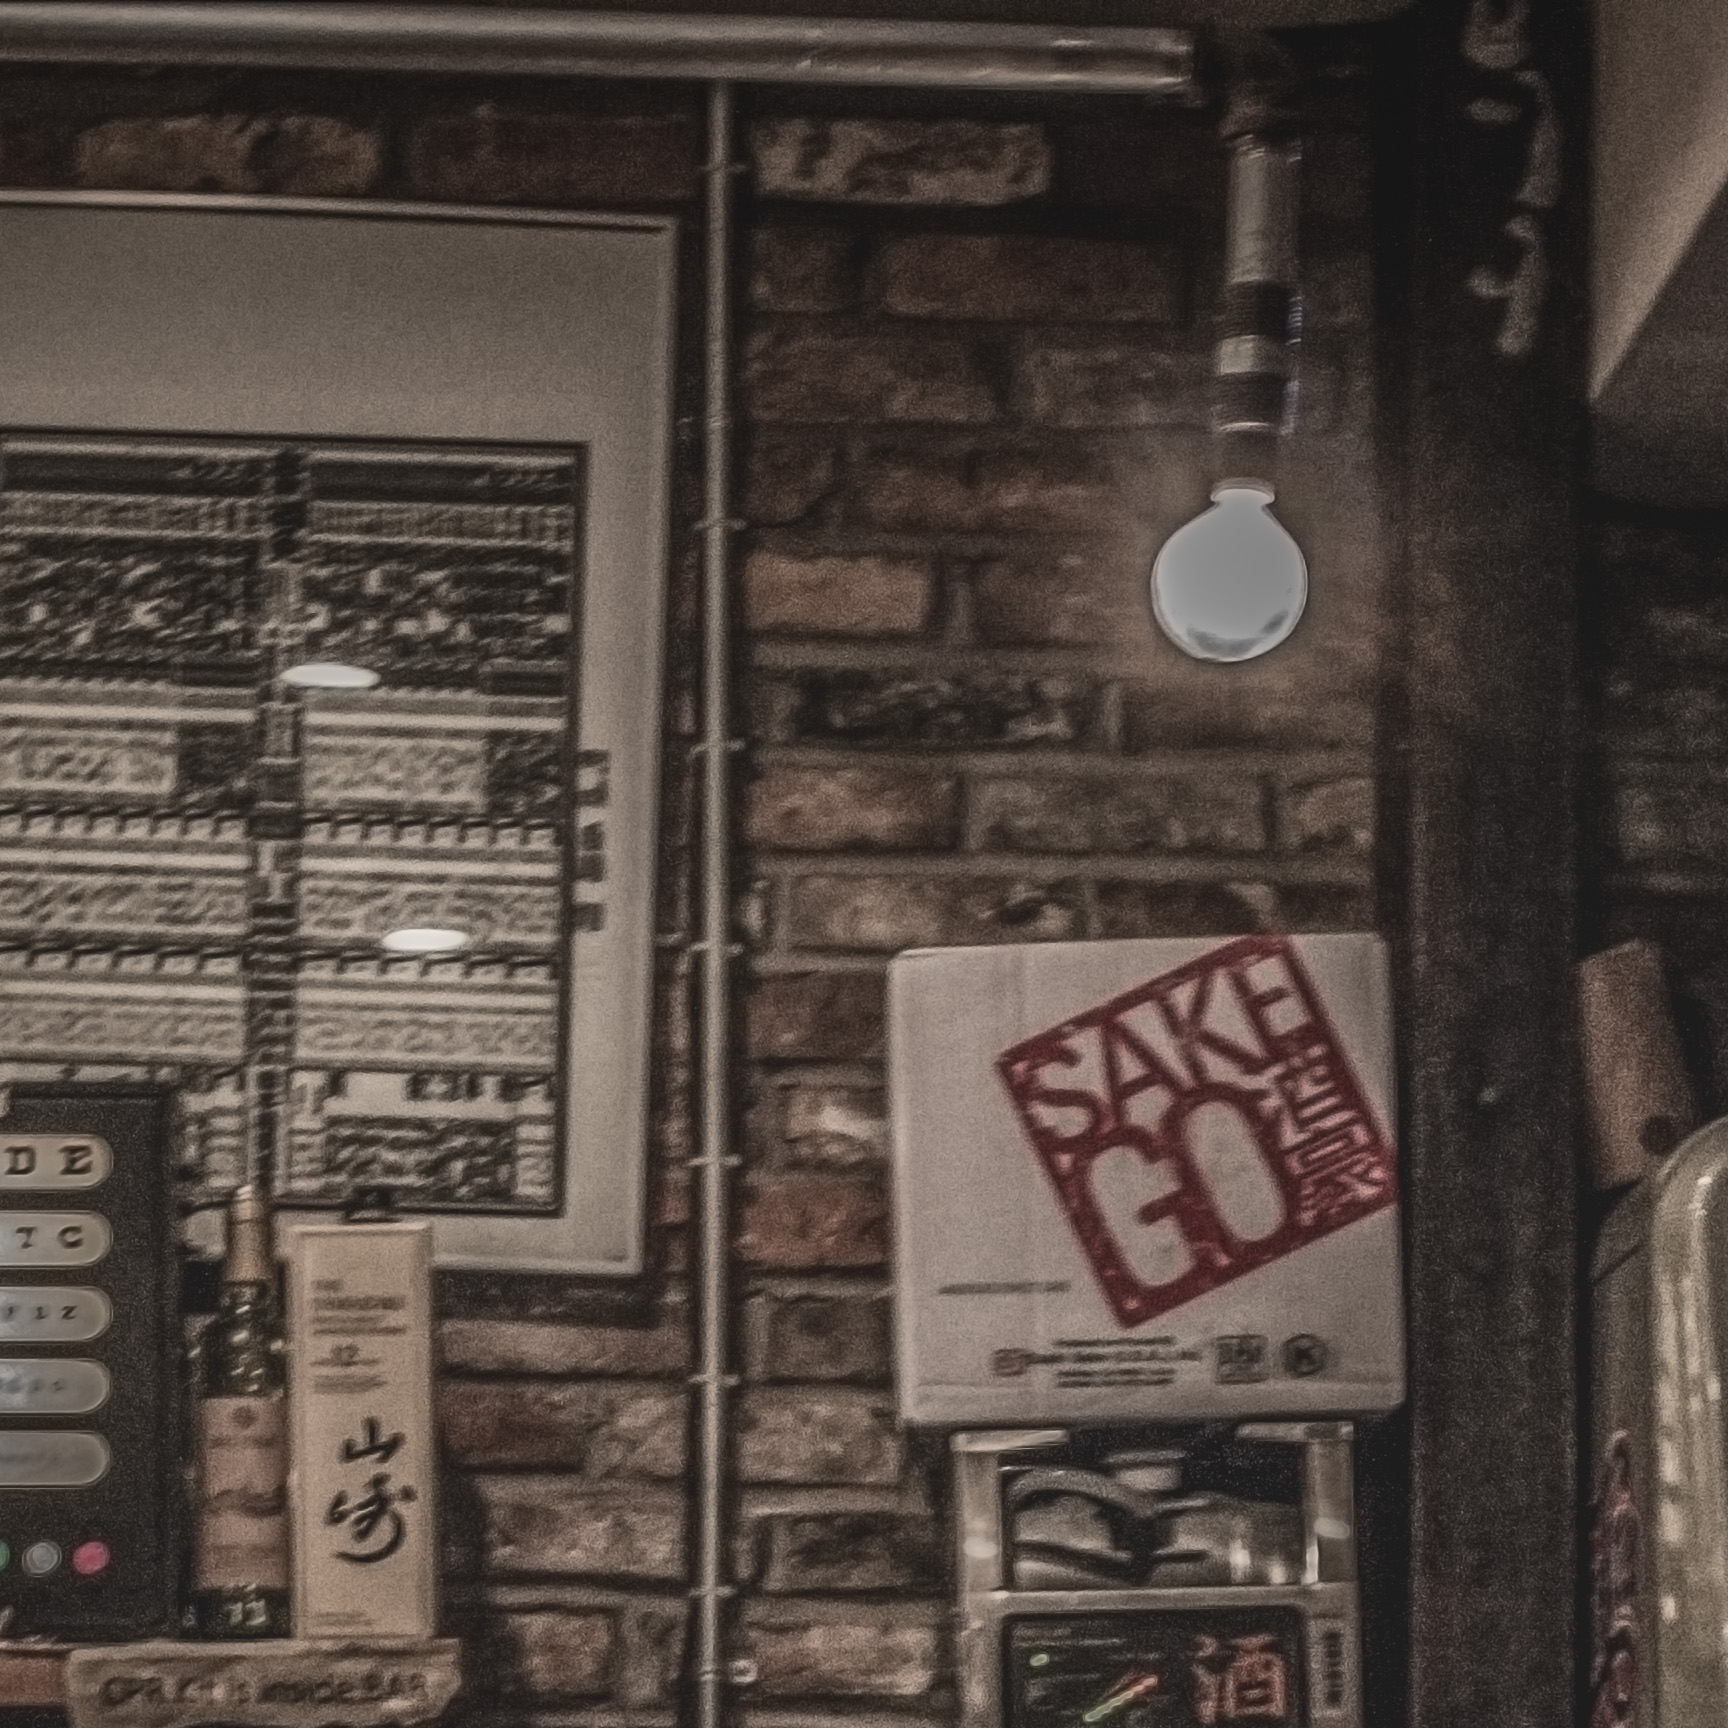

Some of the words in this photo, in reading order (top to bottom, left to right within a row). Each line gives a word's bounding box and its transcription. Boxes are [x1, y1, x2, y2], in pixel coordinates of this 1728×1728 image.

[1010, 940, 1319, 1157] SAKE
[1062, 1070, 1307, 1302] GO
[1189, 1632, 1286, 1725] 酒
